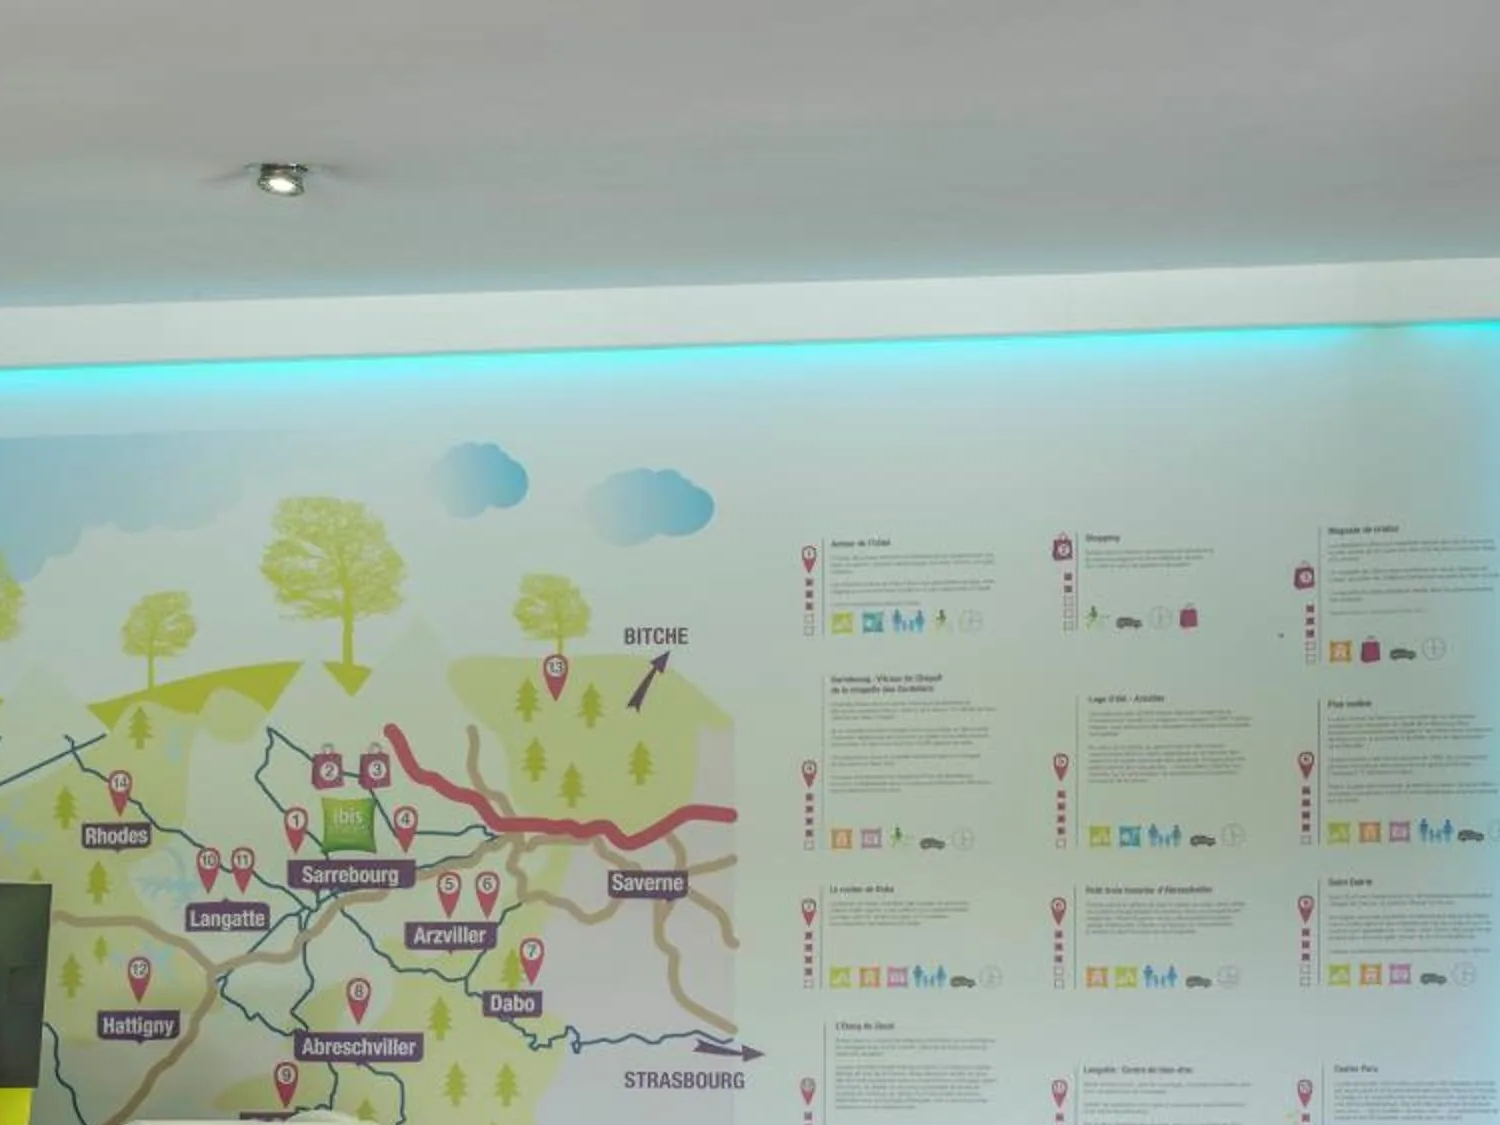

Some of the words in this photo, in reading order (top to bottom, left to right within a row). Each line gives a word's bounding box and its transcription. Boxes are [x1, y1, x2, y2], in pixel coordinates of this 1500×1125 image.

[624, 627, 689, 645] BITCHE
[325, 765, 334, 777] 2
[372, 763, 382, 776] 3
[114, 777, 127, 788] 14
[292, 814, 299, 828] 1
[401, 812, 410, 825] 4
[85, 828, 149, 845] Rhodes
[203, 855, 217, 867] 10
[237, 855, 249, 866] 11
[302, 865, 399, 886] Sarrebourg
[445, 878, 454, 890] 5
[483, 878, 492, 891] 6
[612, 874, 684, 892] Saverne
[189, 909, 265, 931] Langatte
[413, 925, 487, 944] Arzviller
[527, 944, 537, 957] 7
[133, 963, 146, 976] 12
[354, 985, 364, 997] 8
[491, 994, 535, 1012] Dabo
[102, 1016, 176, 1038] Hattigny
[301, 1037, 417, 1057] Abreschviller
[282, 1069, 291, 1081] 9
[624, 1071, 745, 1089] STRASBOURG
